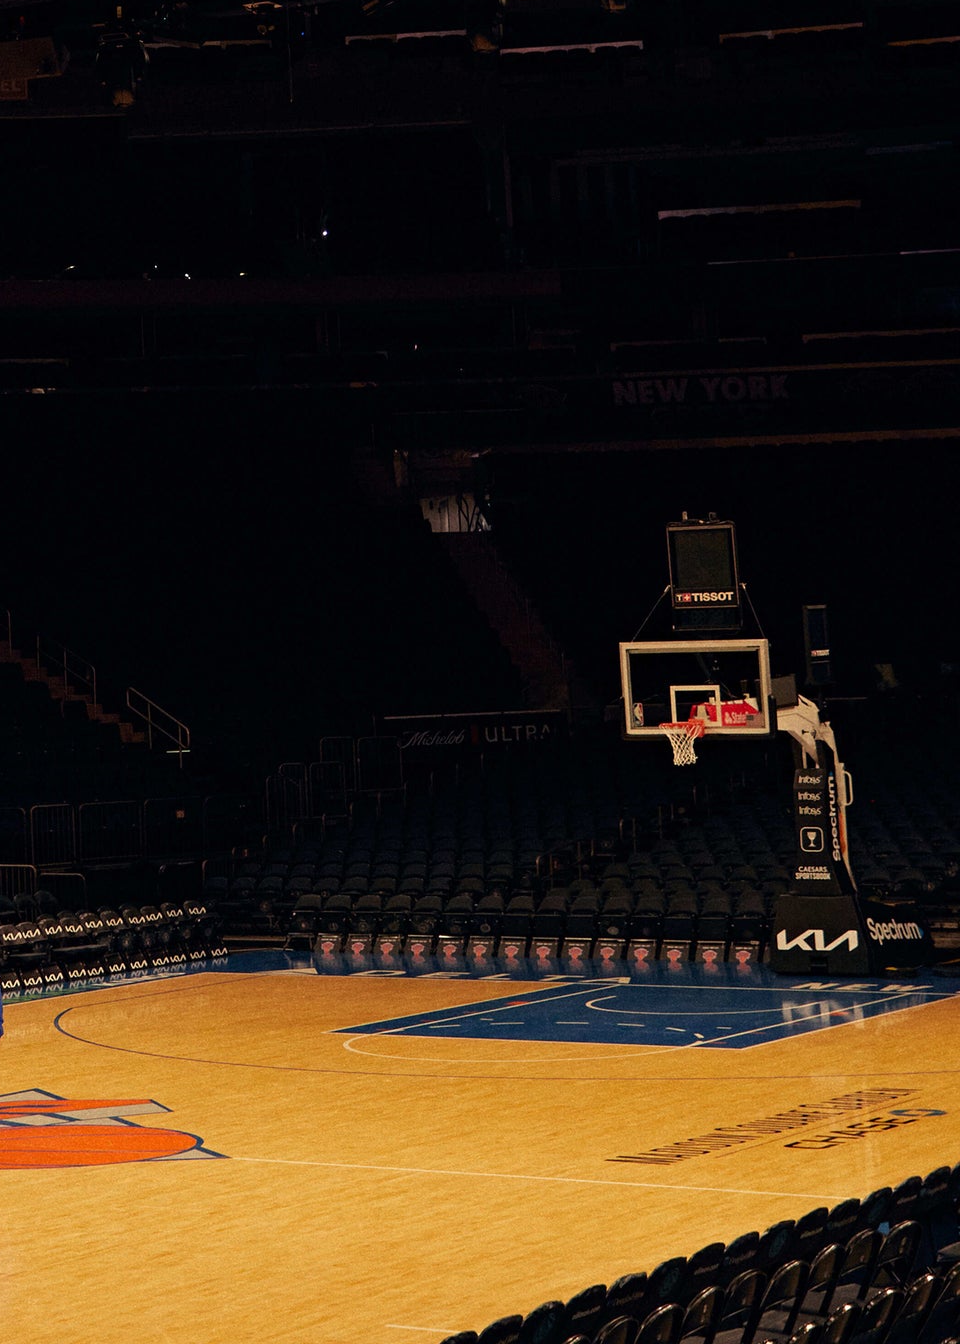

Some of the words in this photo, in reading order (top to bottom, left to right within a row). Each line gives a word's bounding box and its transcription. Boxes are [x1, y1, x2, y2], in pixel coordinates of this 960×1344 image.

[611, 376, 689, 406] NEW
[699, 373, 791, 402] YORK
[691, 591, 735, 602] TISSOT
[775, 927, 859, 952] KIA
[866, 916, 923, 946] Spectrum
[790, 981, 935, 992] NEW
[784, 1117, 919, 1150] CHASE
